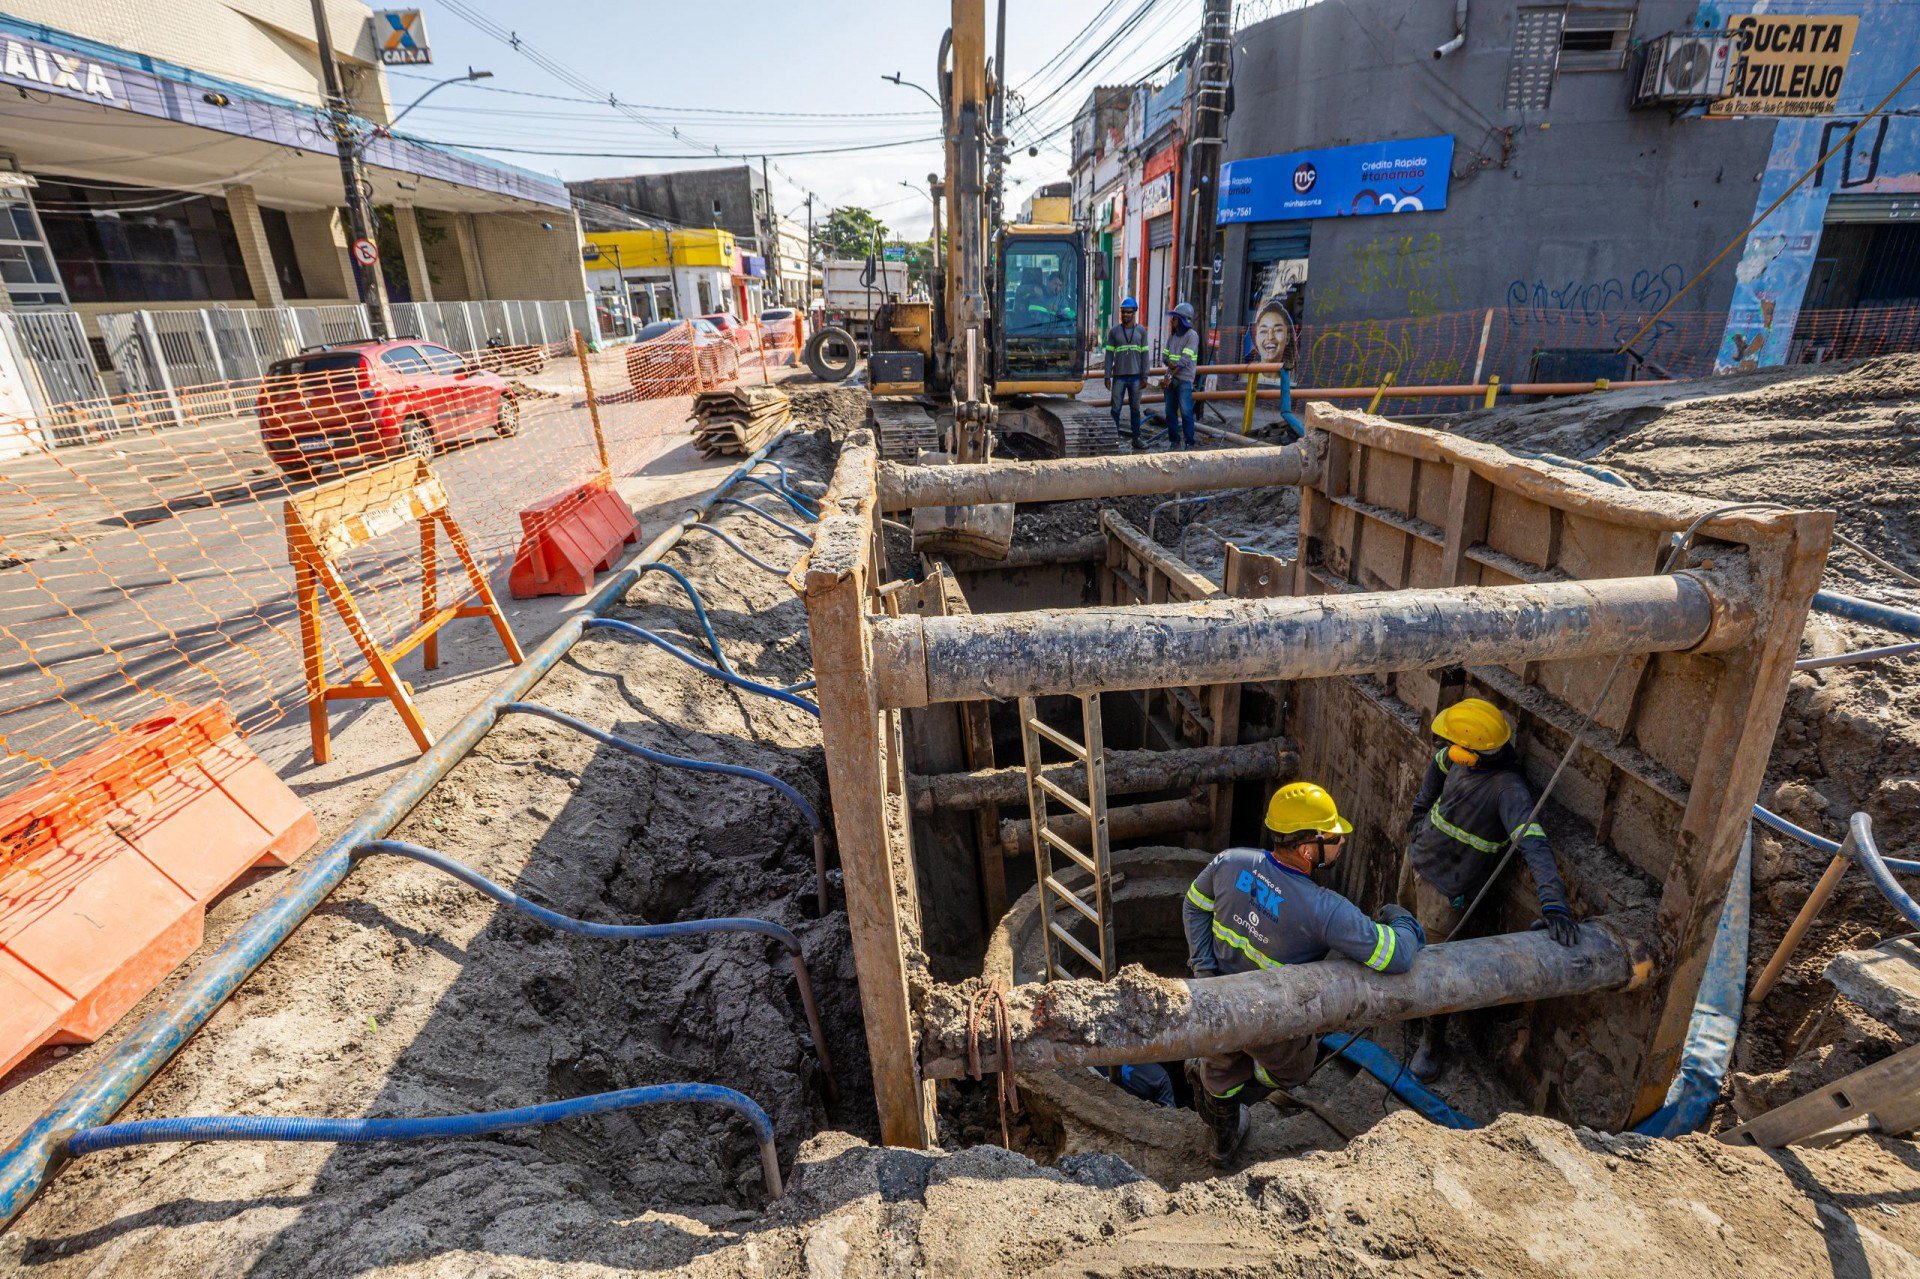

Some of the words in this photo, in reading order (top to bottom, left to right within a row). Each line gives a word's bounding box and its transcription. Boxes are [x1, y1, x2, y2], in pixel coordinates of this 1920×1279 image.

[1736, 17, 1843, 52] SUCATA
[0, 40, 114, 101] AIXA
[383, 49, 427, 63] CAIXA
[1732, 56, 1843, 98] AZULEIJO
[1361, 160, 1393, 171] Crédito
[1394, 157, 1427, 169] Rápido
[1361, 168, 1425, 182] #tanamão
[1284, 198, 1321, 207] minhaconta
[1235, 869, 1284, 917] BRK
[1233, 914, 1268, 944] compesa
